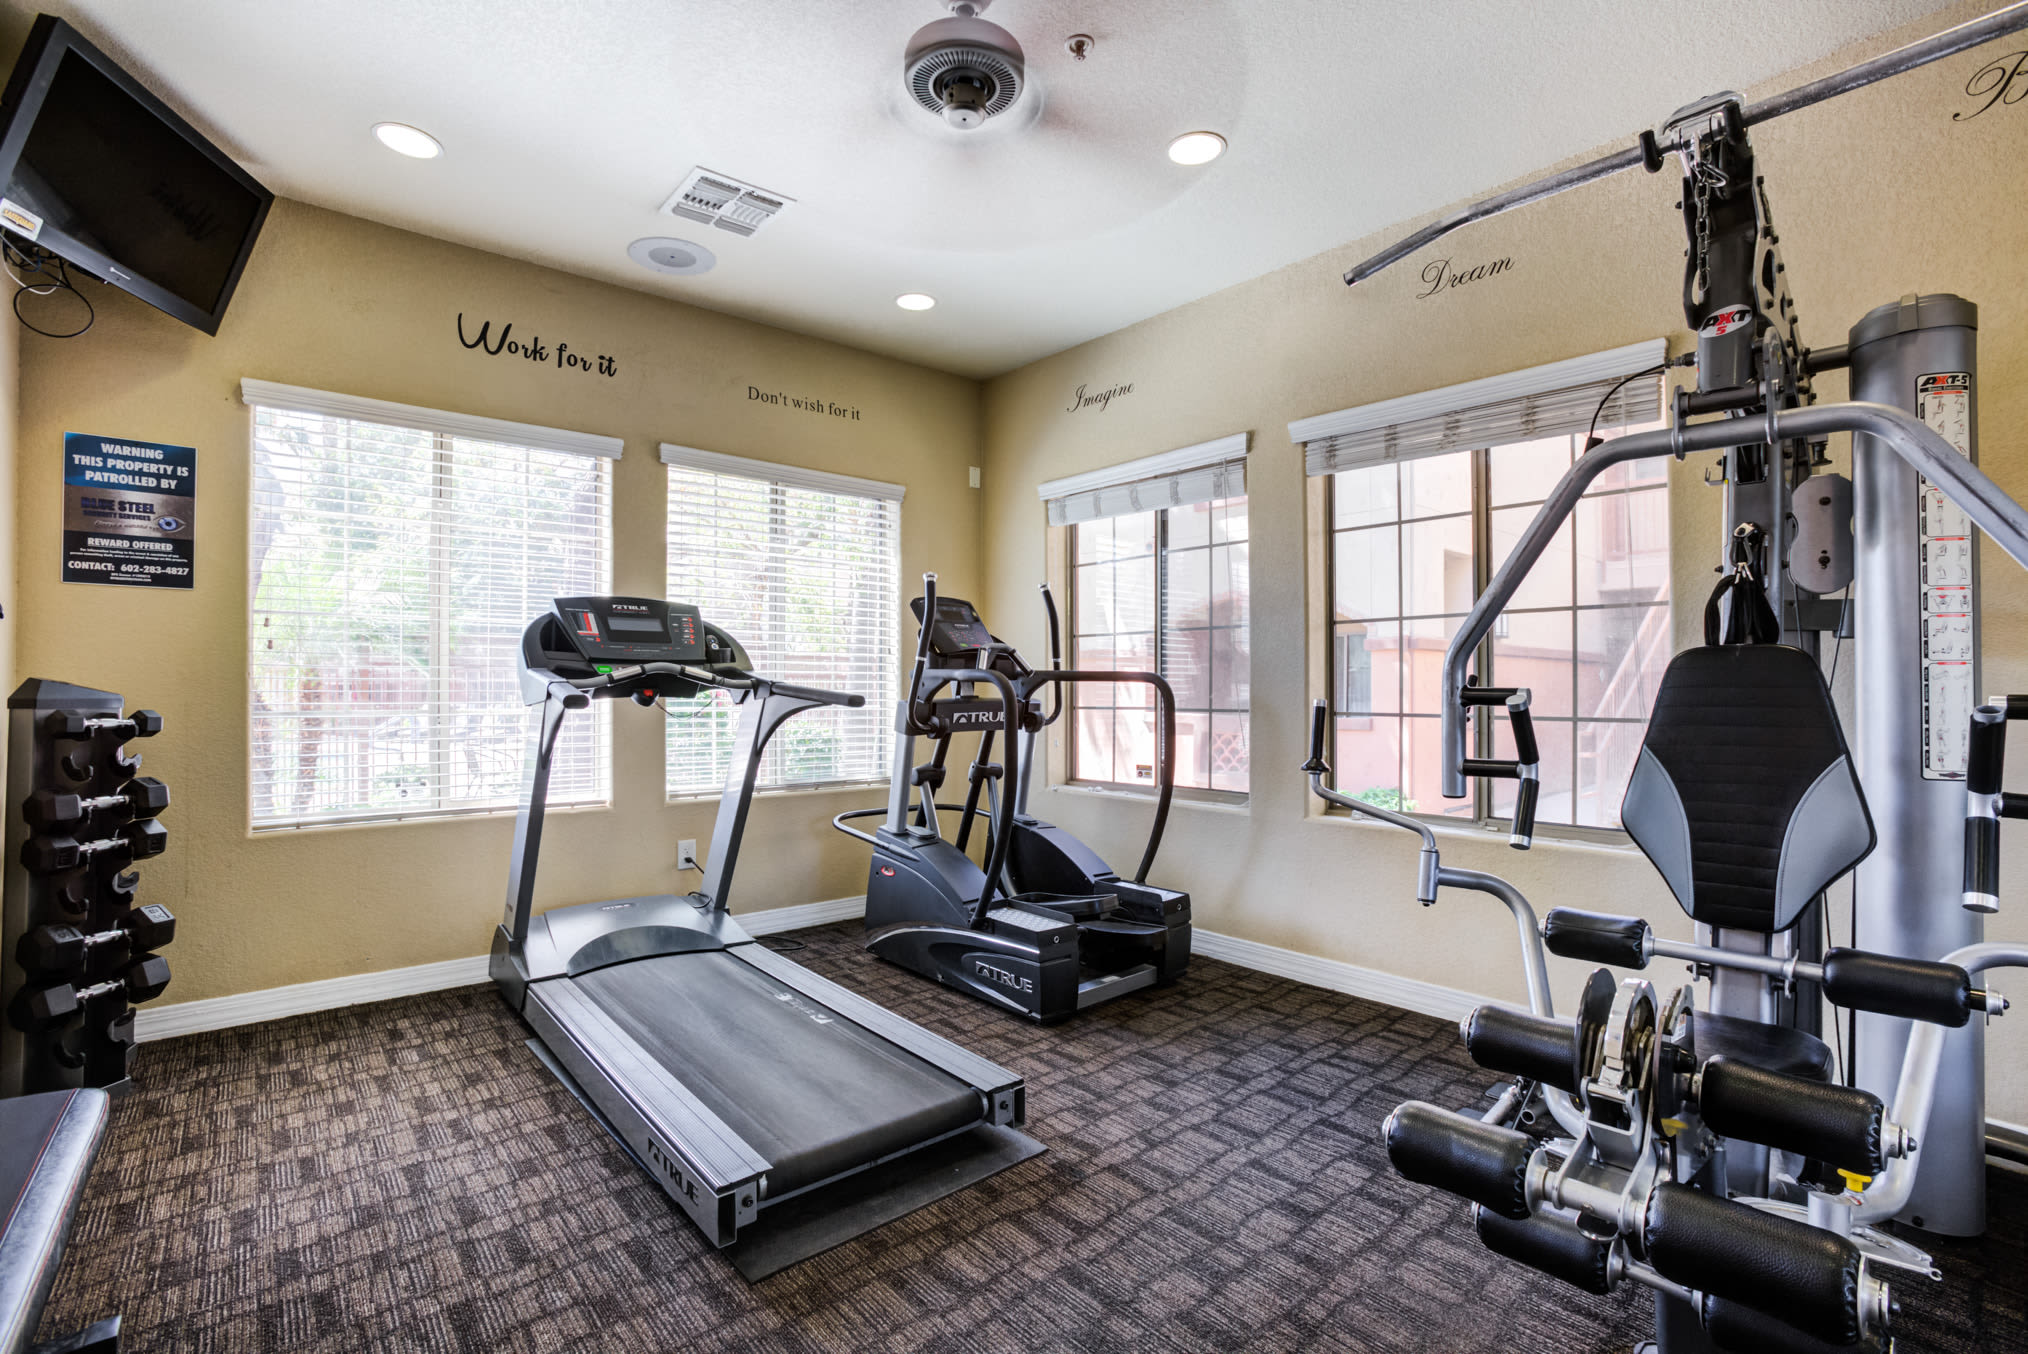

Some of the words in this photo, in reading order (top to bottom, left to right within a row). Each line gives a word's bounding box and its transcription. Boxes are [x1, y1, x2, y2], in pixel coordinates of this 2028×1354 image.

[1414, 255, 1515, 300] Dream
[458, 312, 549, 363] Work
[556, 342, 592, 372] for
[598, 354, 618, 377] it
[747, 385, 788, 407] Don't
[792, 396, 825, 414] wish
[828, 402, 849, 418] for
[851, 406, 861, 421] it
[1065, 381, 1135, 413] Imagine
[100, 443, 164, 460] WARNING
[72, 454, 104, 467] THIS
[107, 458, 174, 475] PROPERTY
[176, 466, 189, 477] IS
[85, 470, 157, 487] PATROLLED
[160, 478, 178, 490] BY
[118, 500, 156, 514] STEEL
[87, 537, 130, 548] REWARD
[132, 540, 173, 551] OFFERED
[68, 560, 115, 571] CONTACT:
[120, 563, 189, 576] 602-283-4827
[968, 711, 1005, 723] TRUE
[989, 966, 1033, 993] TRUE
[660, 1150, 699, 1207] TRUE
